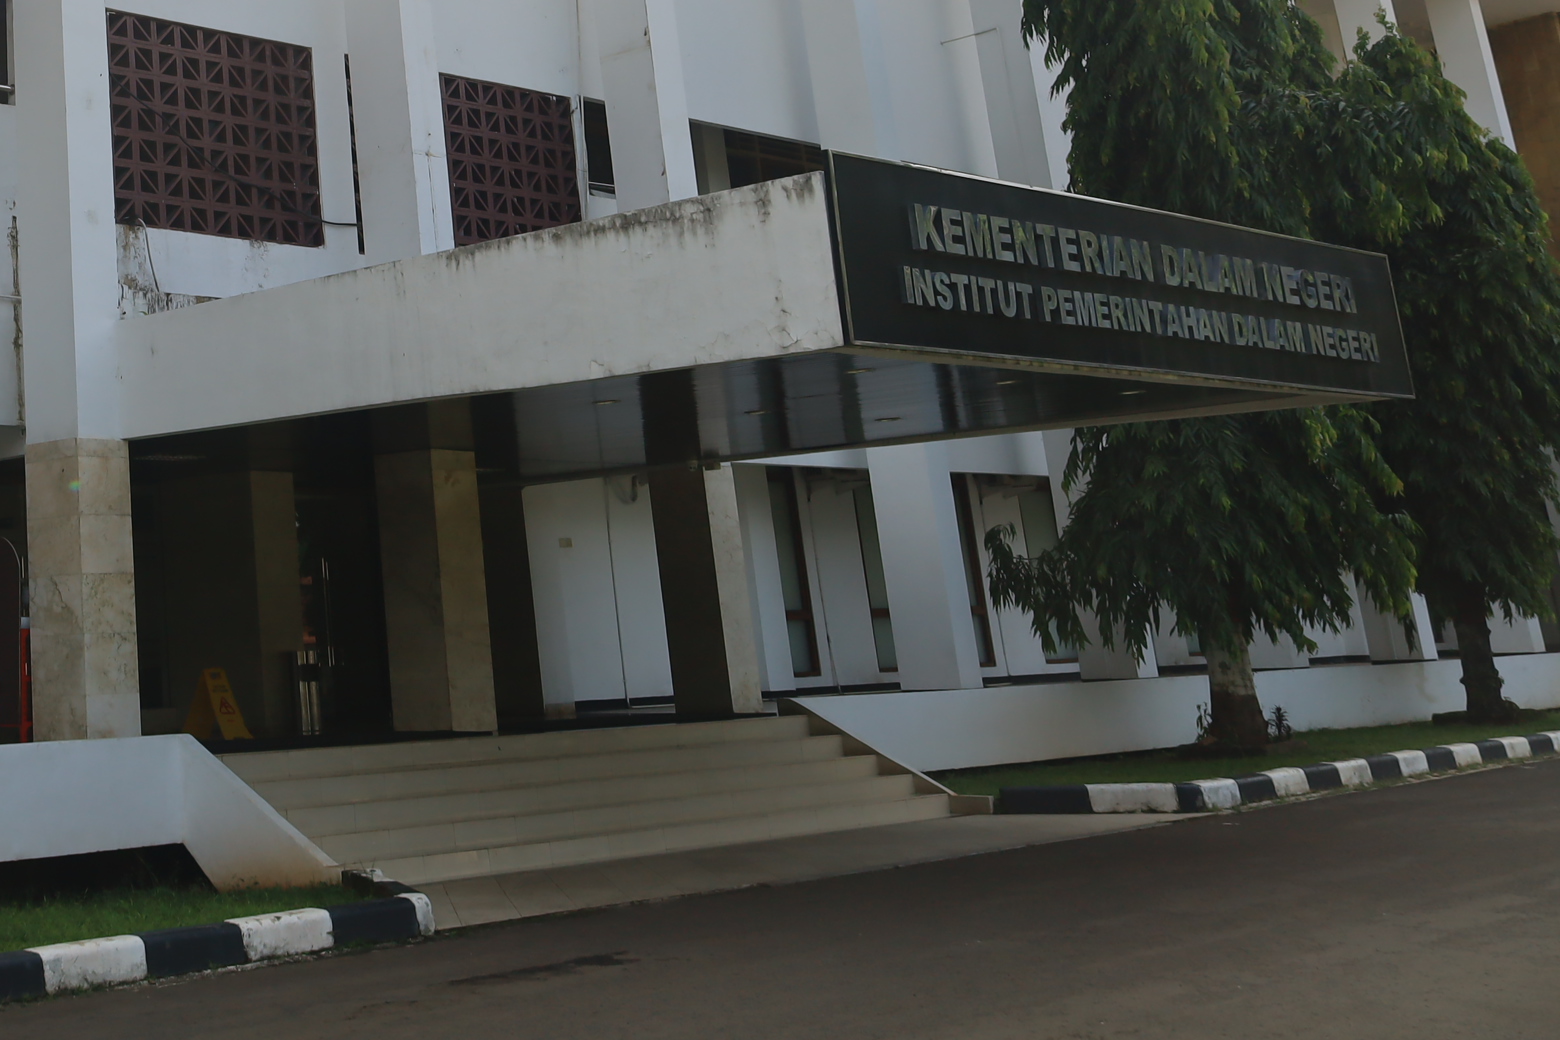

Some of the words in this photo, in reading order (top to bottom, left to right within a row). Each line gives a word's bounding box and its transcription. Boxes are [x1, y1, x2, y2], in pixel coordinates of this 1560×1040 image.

[909, 203, 1154, 282] KEMENTERIAN
[1160, 244, 1258, 298] DALAM
[1261, 262, 1357, 314] NEGERI
[901, 265, 1033, 319] INSTITUT
[1041, 286, 1229, 344] PEMERINTAHAN
[1232, 313, 1306, 353] DALAM
[1307, 323, 1380, 362] NEGERI
